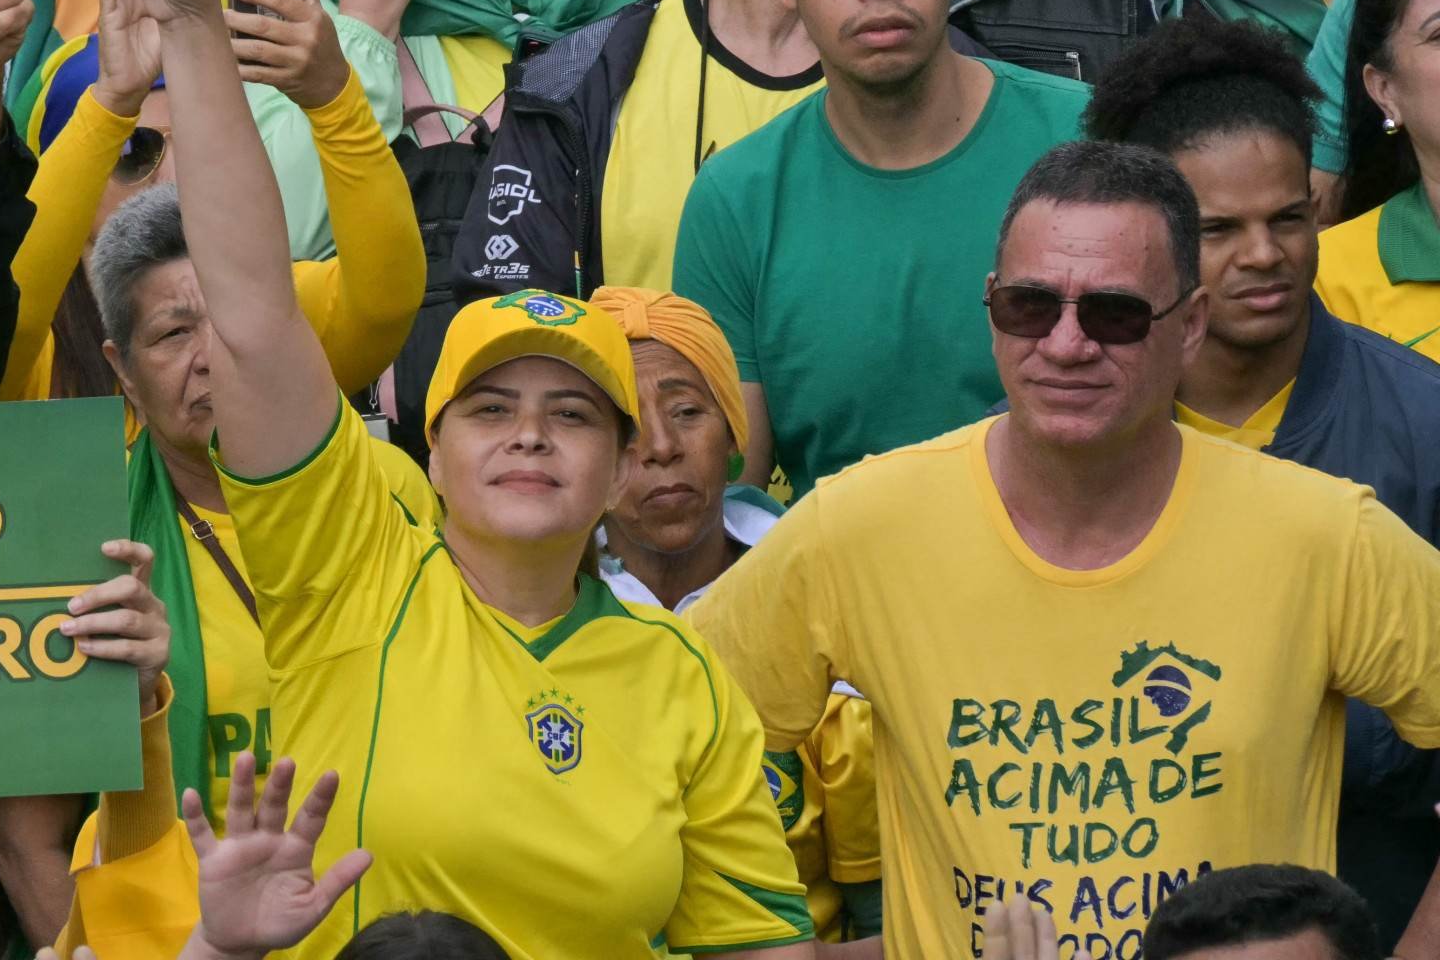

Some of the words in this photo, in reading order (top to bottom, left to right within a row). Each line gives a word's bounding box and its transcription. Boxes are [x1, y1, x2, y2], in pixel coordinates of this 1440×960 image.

[946, 696, 1170, 755] BRASIL
[944, 756, 1137, 817] ACIMA
[1148, 751, 1224, 804] DE
[1008, 817, 1159, 870] TUDO
